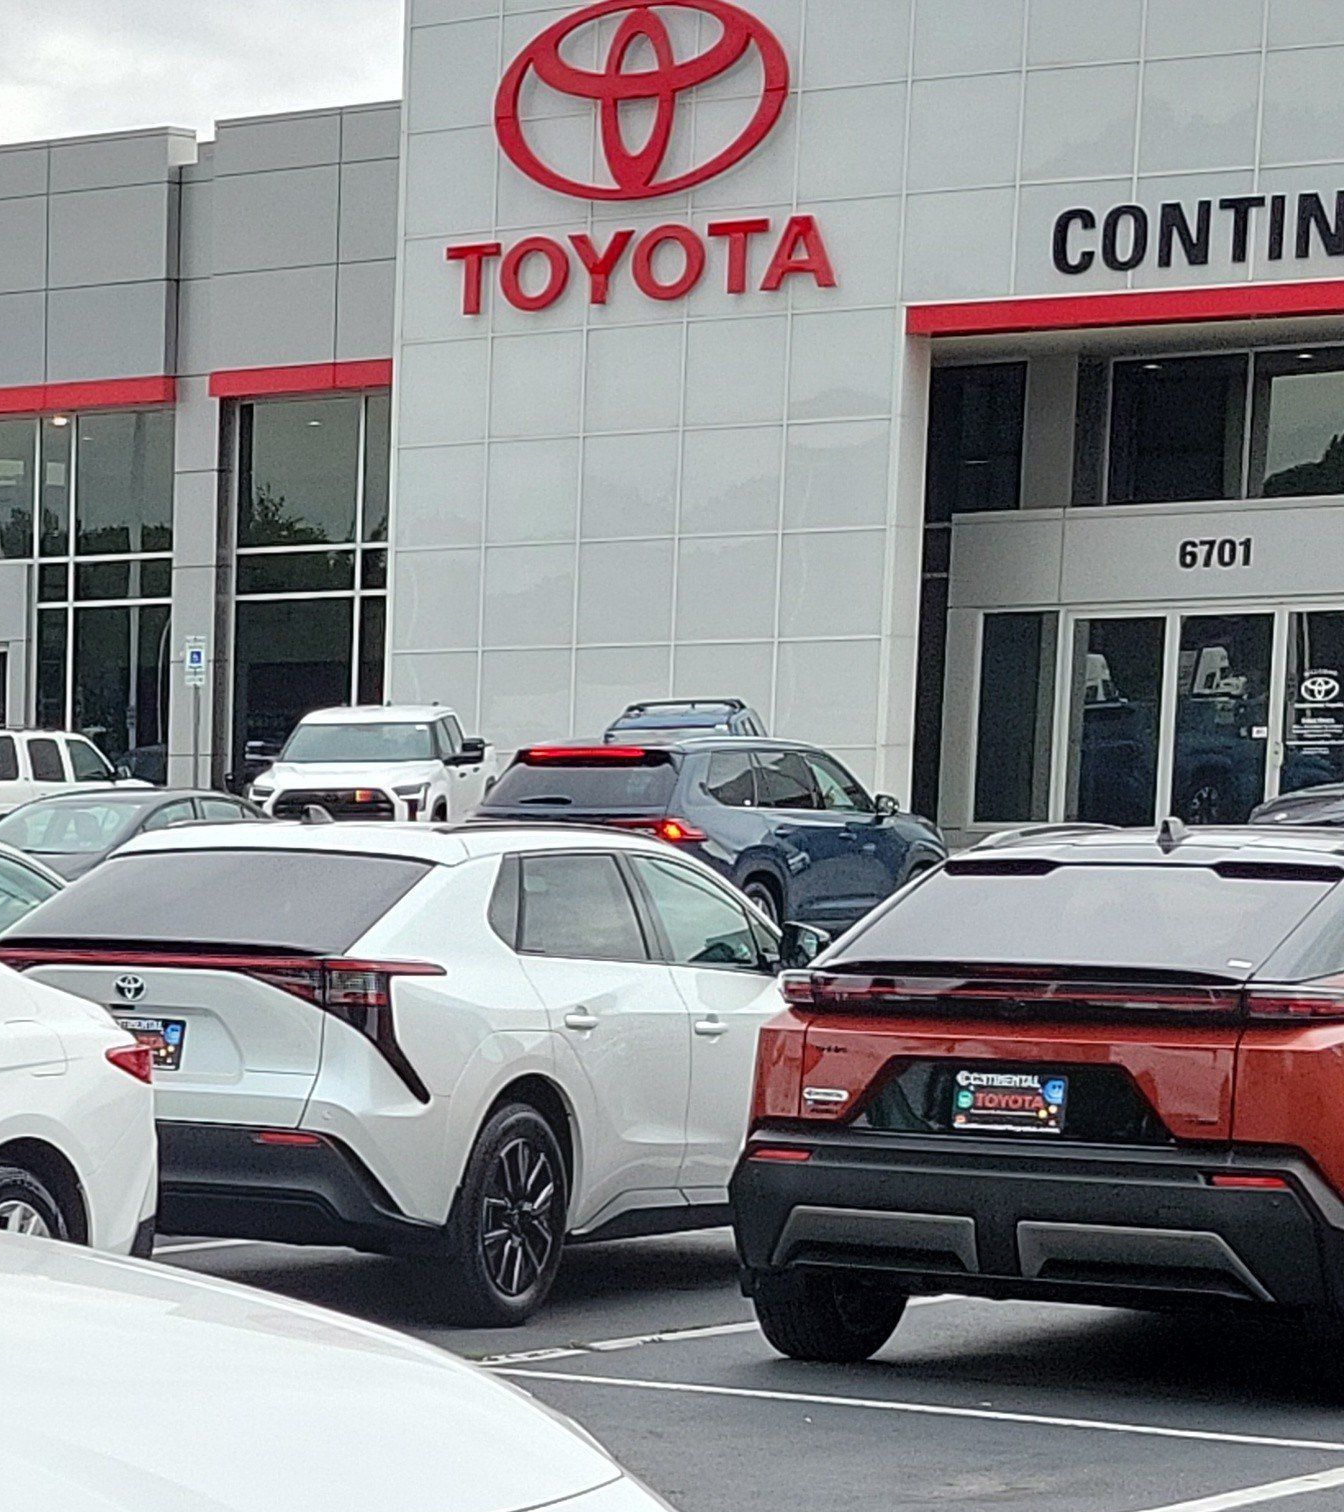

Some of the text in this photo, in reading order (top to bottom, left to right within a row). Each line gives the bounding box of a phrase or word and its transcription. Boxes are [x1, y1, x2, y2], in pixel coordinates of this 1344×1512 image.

[1052, 190, 1344, 275] CONTIN
[445, 214, 836, 314] TOYOTA
[1179, 537, 1252, 569] 6701
[974, 1091, 1044, 1109] TOYOTA
